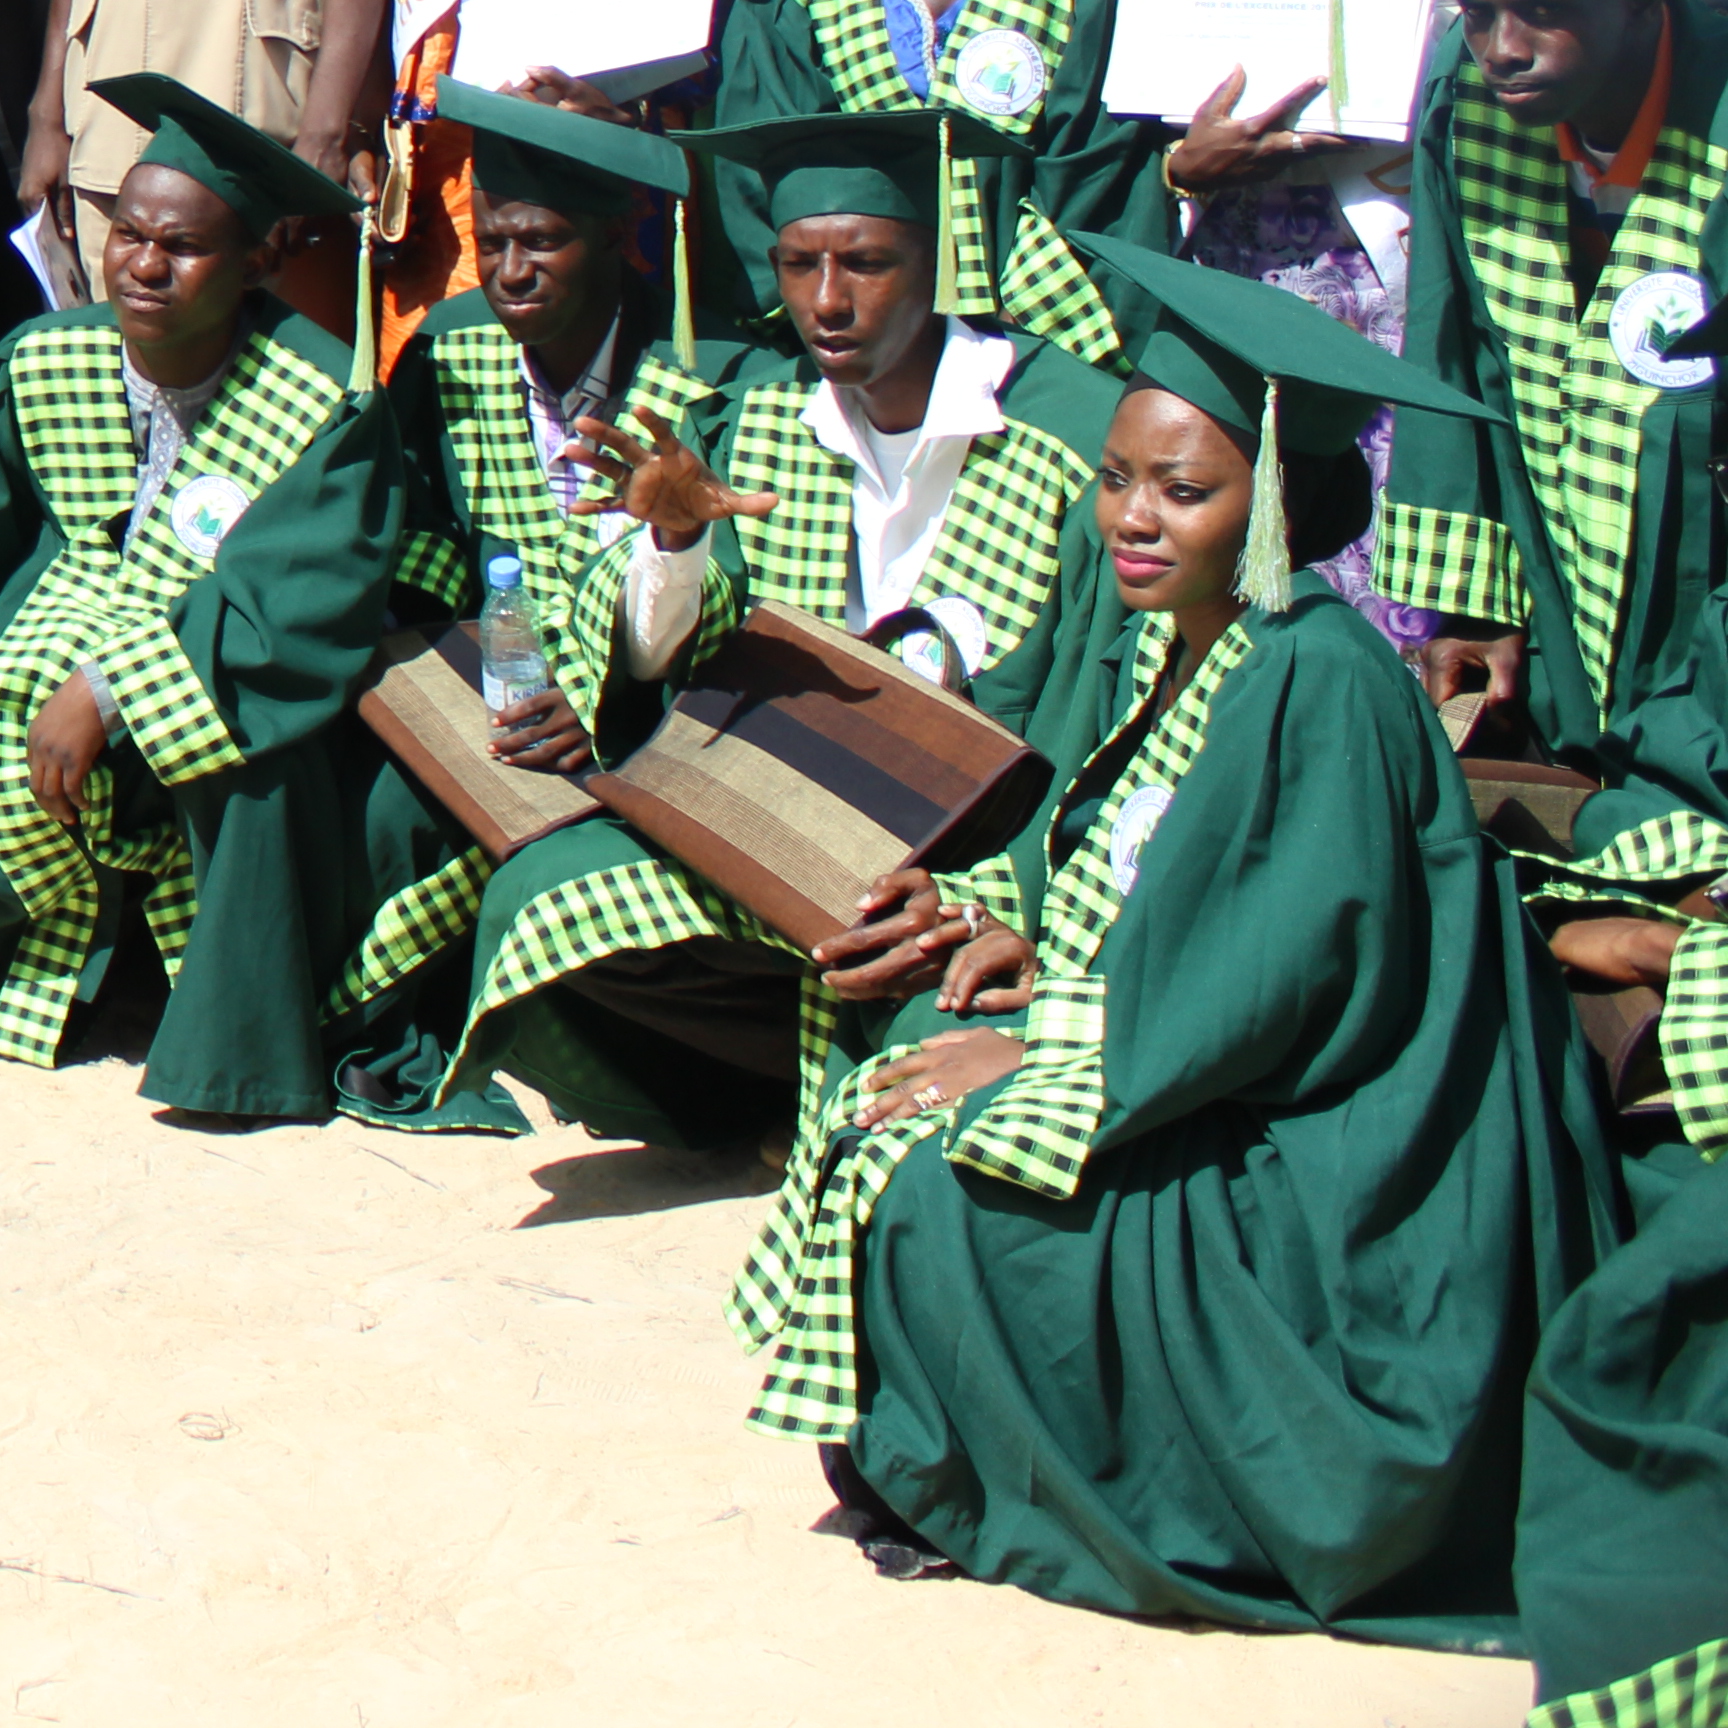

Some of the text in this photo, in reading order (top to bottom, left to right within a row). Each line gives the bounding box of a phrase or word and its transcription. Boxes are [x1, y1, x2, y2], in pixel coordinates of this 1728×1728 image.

[1195, 1, 1217, 9] PRIX
[1236, 2, 1306, 11] L'EXCELLENCE
[1310, 3, 1327, 12] 201
[1616, 276, 1703, 316] UNIVERSITE ASSA
[1627, 359, 1702, 385] ZIGUINCHOR
